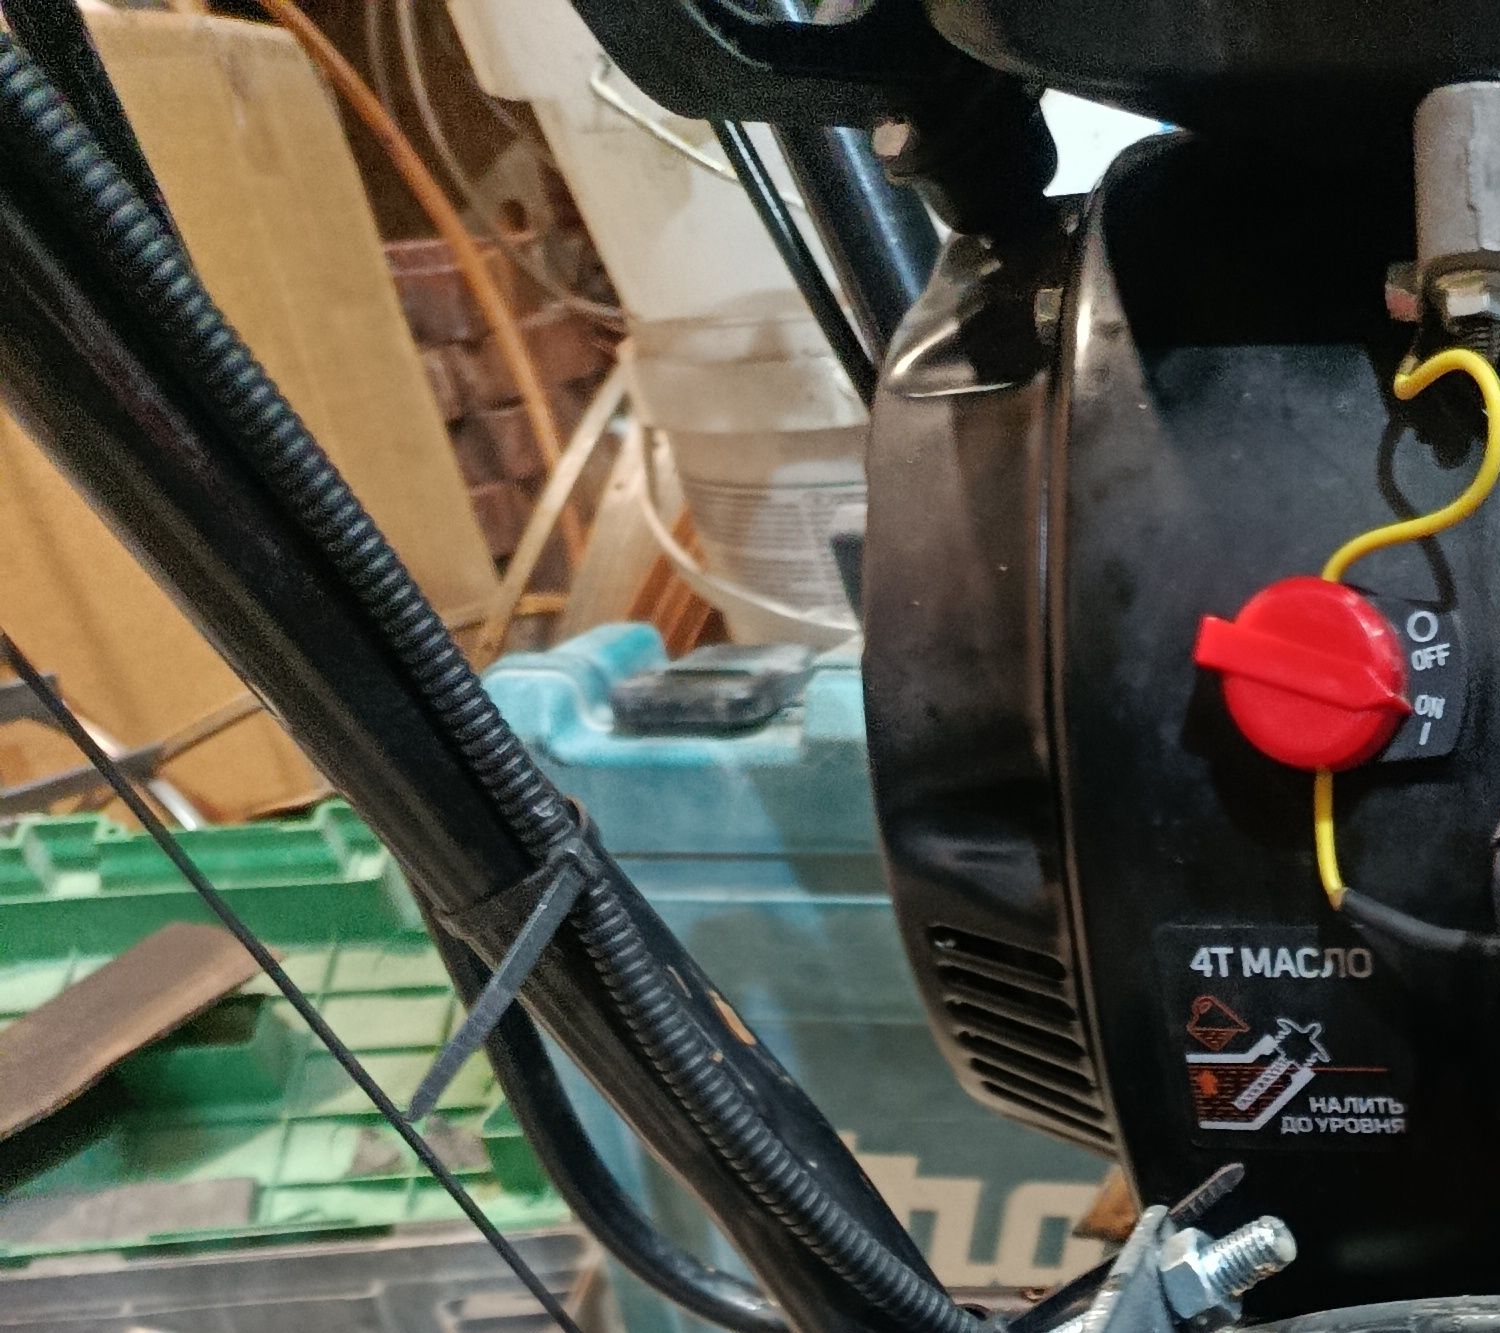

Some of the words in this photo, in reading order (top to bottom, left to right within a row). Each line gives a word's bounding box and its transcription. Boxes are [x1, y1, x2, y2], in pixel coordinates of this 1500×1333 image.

[1411, 643, 1451, 671] OFF
[1414, 694, 1446, 719] ON
[1240, 947, 1374, 979] МАСЛО
[1308, 1096, 1405, 1115] НАЛИТЬ
[1279, 1116, 1314, 1135] ДО
[1314, 1116, 1407, 1135] УРОВНЯ
